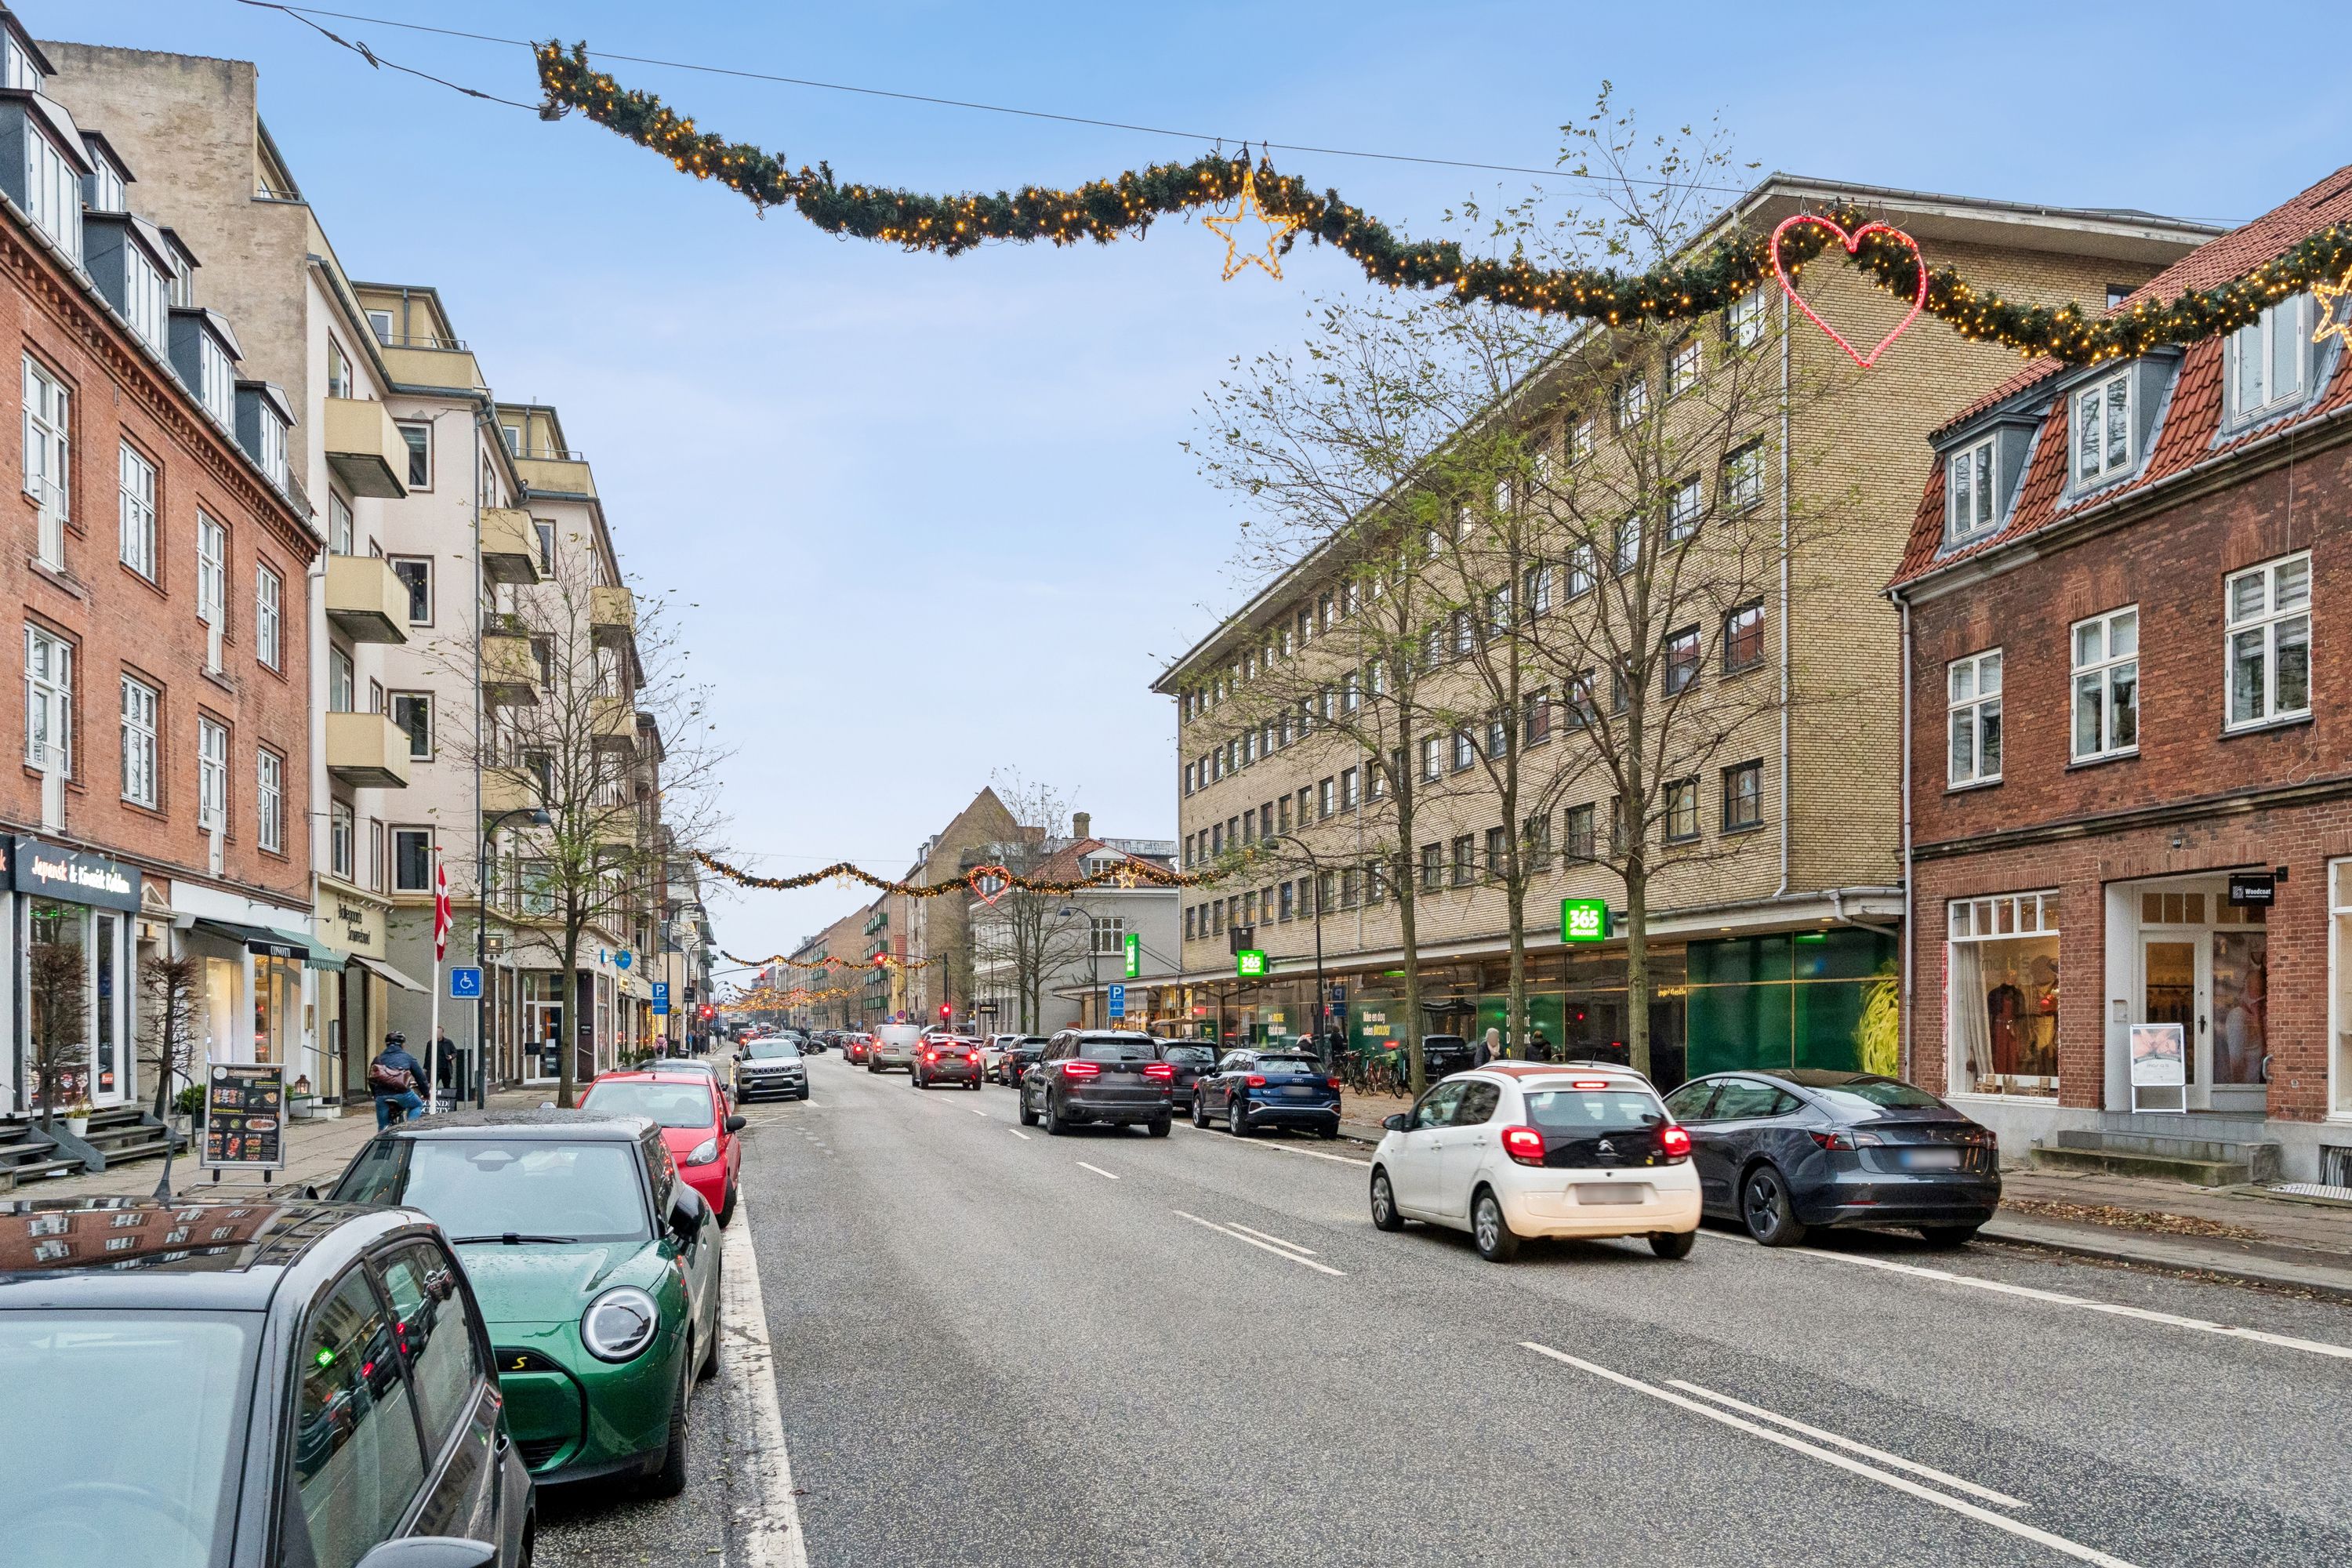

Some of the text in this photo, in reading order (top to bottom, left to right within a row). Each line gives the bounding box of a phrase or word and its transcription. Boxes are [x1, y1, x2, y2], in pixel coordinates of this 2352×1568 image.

[69, 864, 78, 883] &
[1570, 910, 1599, 928] 365
[1242, 957, 1261, 968] 365
[656, 985, 665, 996] P
[1113, 987, 1121, 998] P
[511, 1356, 528, 1370] S
